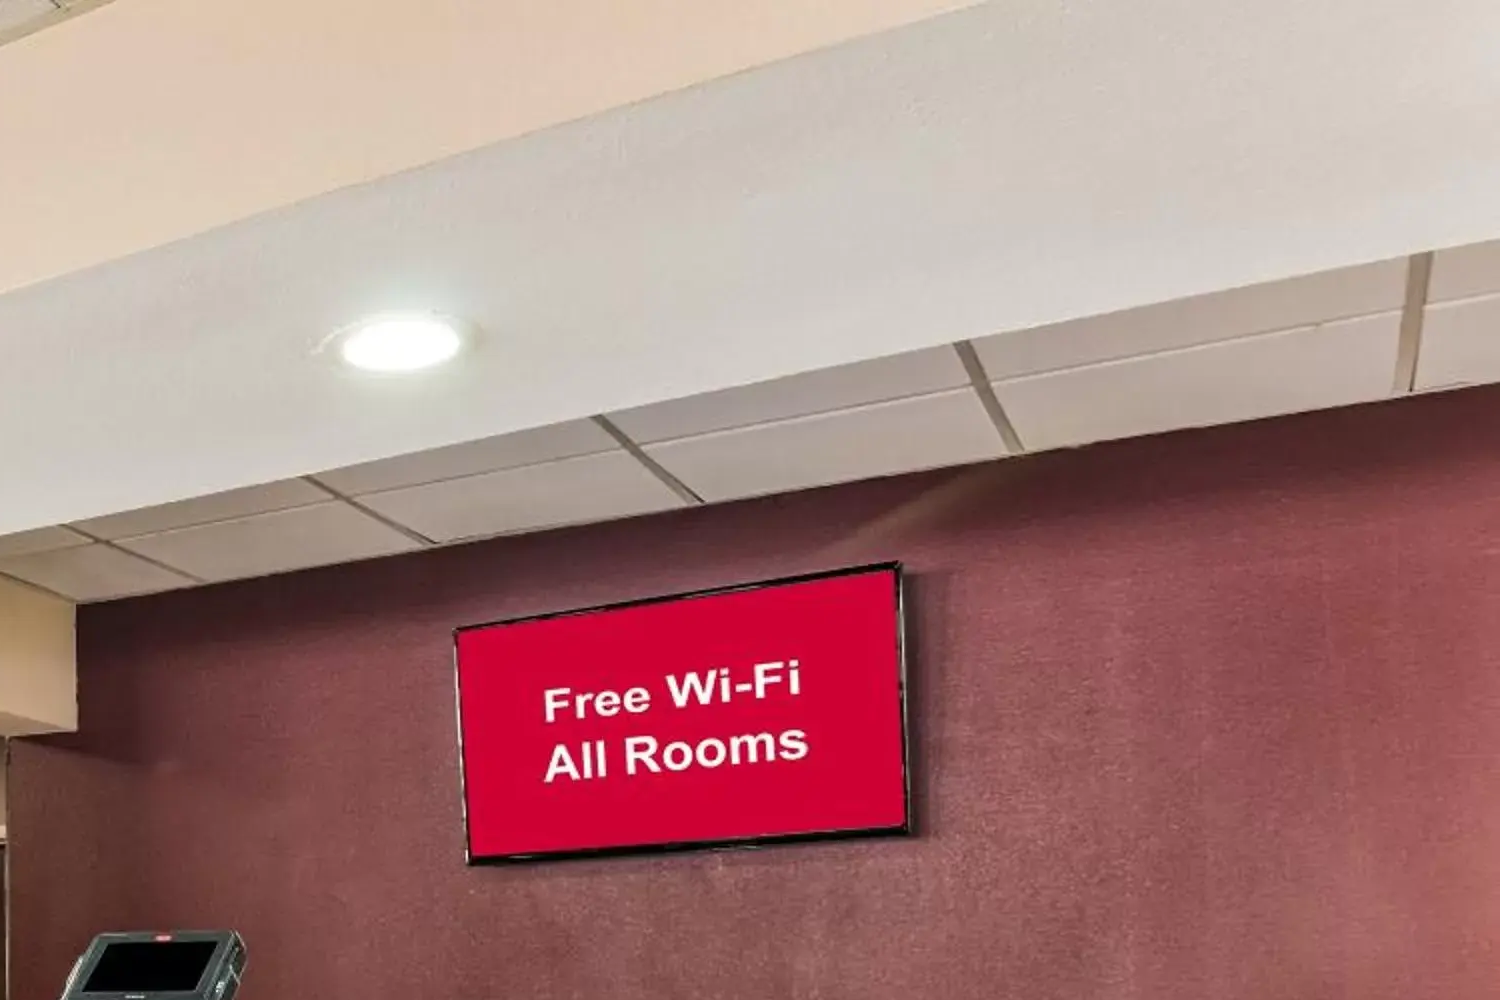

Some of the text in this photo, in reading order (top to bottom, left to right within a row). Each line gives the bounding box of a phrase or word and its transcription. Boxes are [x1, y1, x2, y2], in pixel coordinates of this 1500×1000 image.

[544, 659, 800, 723] Free Wi-Fi
[543, 729, 809, 783] All Rooms
